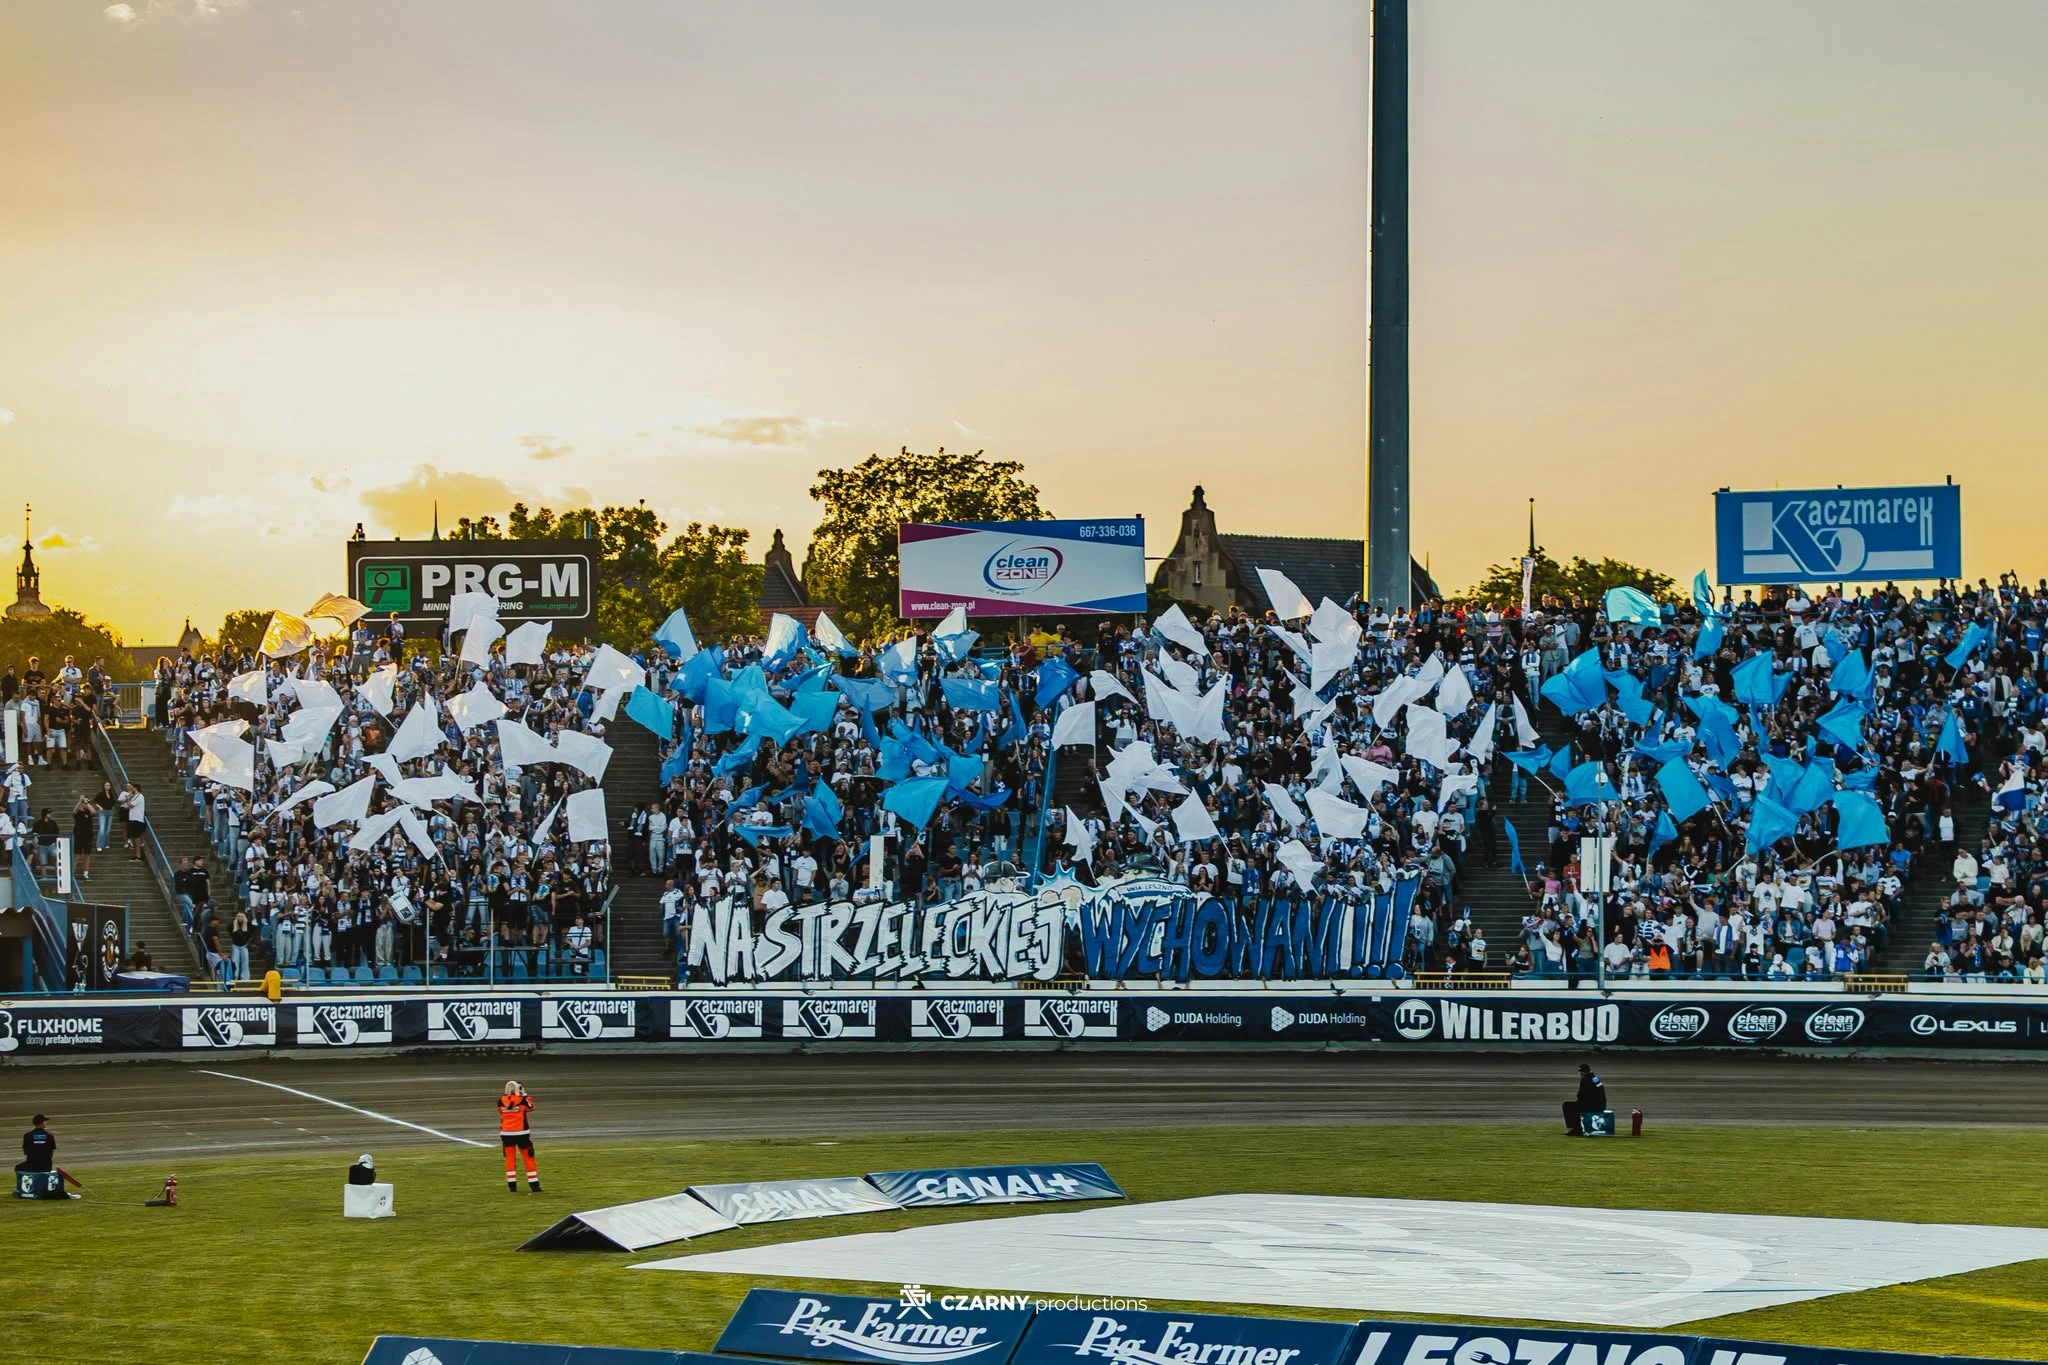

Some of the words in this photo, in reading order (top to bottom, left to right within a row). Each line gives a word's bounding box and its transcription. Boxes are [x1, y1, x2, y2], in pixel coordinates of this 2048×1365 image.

[1079, 525, 1137, 538] 667-336-036
[1772, 496, 1933, 576] Kaczmarek
[996, 554, 1049, 568] clean
[996, 568, 1048, 580] ZONE
[421, 563, 579, 599] PRG-M
[422, 602, 449, 612] MININ
[910, 600, 976, 611] www.clean-zone.pl
[688, 896, 757, 987] NA
[756, 898, 1068, 983] STRZELECKIEJ
[196, 1007, 276, 1047] Kaczmarek
[312, 1005, 392, 1045] Kaczmarek
[442, 1001, 521, 1041] Kaczmarek
[557, 1000, 635, 1039] Kaczmarek
[685, 1000, 762, 1039] Kaczmarek
[799, 1000, 876, 1038] Kaczmarek
[926, 1000, 1003, 1038] Kaczmarek
[1040, 1000, 1117, 1038] Kaczmarek
[1174, 1013, 1203, 1024] DUDA
[1205, 1013, 1242, 1027] Holding
[1299, 1013, 1328, 1024] DUDA
[1330, 1013, 1366, 1027] Holding
[1440, 999, 1620, 1042] WILERBUD
[1660, 1013, 1699, 1023] clean
[1660, 1023, 1697, 1031] ZONE
[1737, 1013, 1776, 1023] clean
[1737, 1023, 1775, 1031] ZONE
[1814, 1014, 1854, 1024] clean
[1814, 1024, 1853, 1032] ZONE
[1939, 1020, 2017, 1032] LEXUS
[26, 1036, 45, 1045] domy
[45, 1035, 103, 1045] prefabrykowane
[916, 1173, 1079, 1199] CANAL+
[731, 1187, 854, 1219] CANAL+
[779, 1298, 846, 1347] Pig
[854, 1303, 987, 1346] Farmer
[1074, 1316, 1145, 1365] Pig
[1154, 1321, 1301, 1365] Farmer
